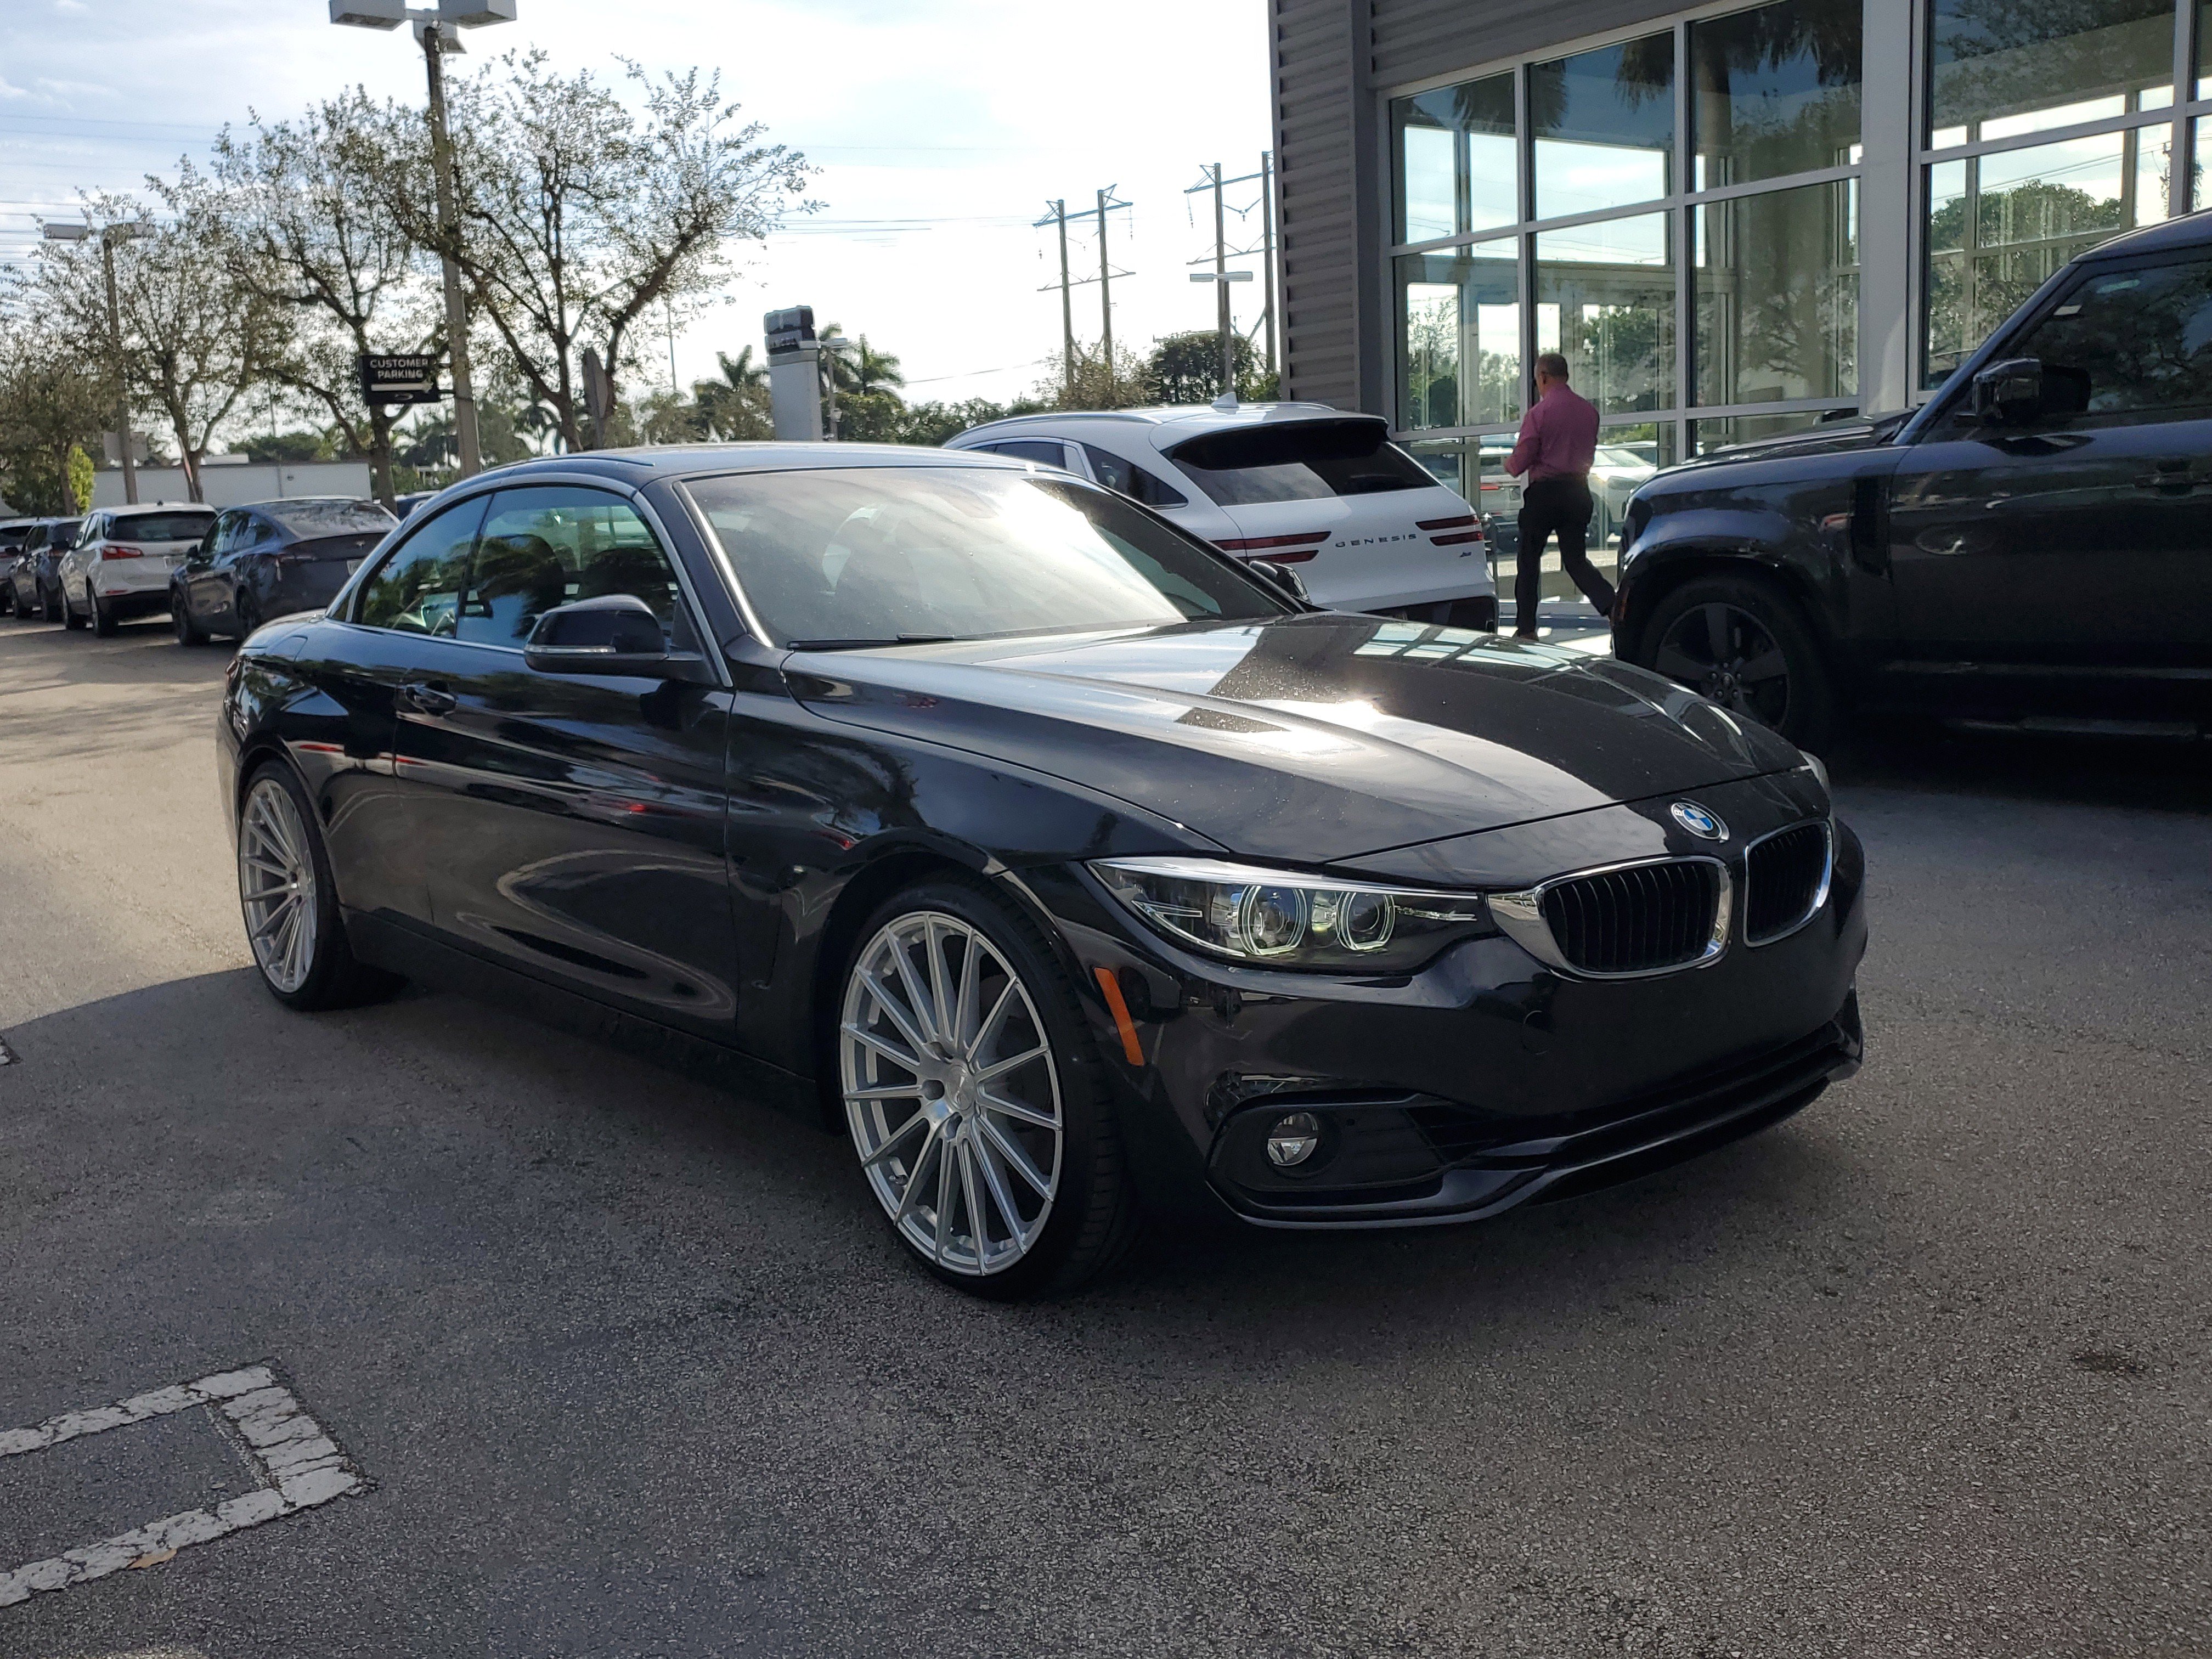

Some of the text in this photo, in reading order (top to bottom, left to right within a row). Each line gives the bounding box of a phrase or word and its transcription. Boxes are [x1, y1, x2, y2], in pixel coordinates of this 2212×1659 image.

[370, 358, 428, 369] CUSTOMER
[377, 369, 424, 379] PARKING
[1335, 534, 1417, 548] GENESIS
